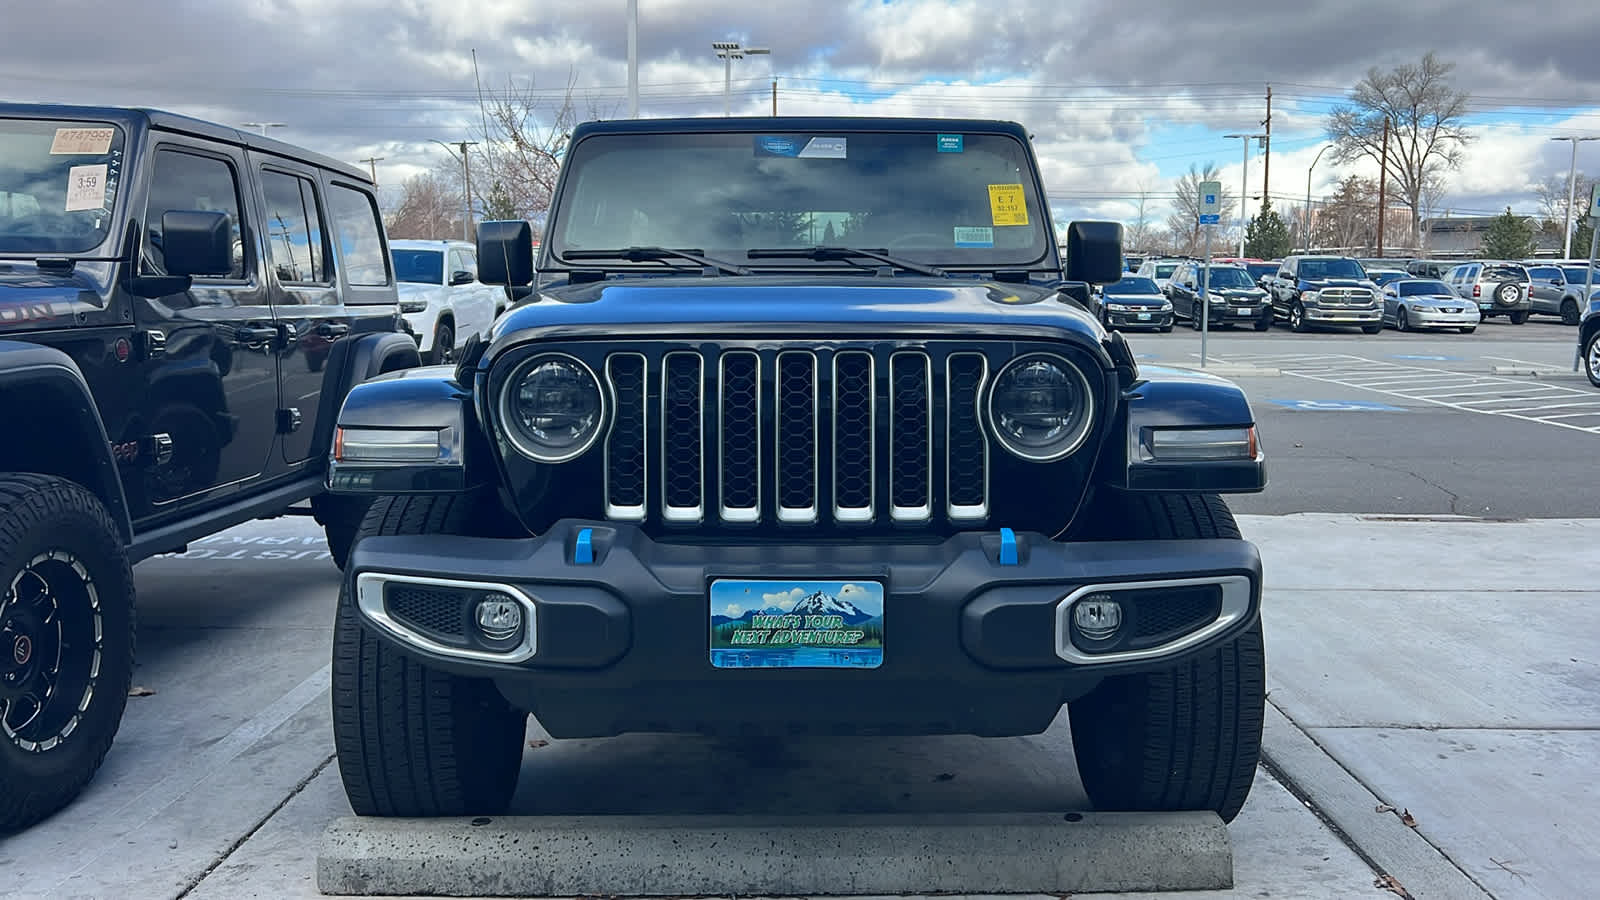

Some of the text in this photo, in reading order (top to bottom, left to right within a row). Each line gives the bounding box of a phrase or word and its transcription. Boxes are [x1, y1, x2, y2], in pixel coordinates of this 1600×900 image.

[78, 176, 97, 189] 3:59
[111, 440, 137, 464] eep
[752, 615, 843, 629] WHAT'S YOUR
[731, 630, 864, 645] NEXT ADVENTURE?
